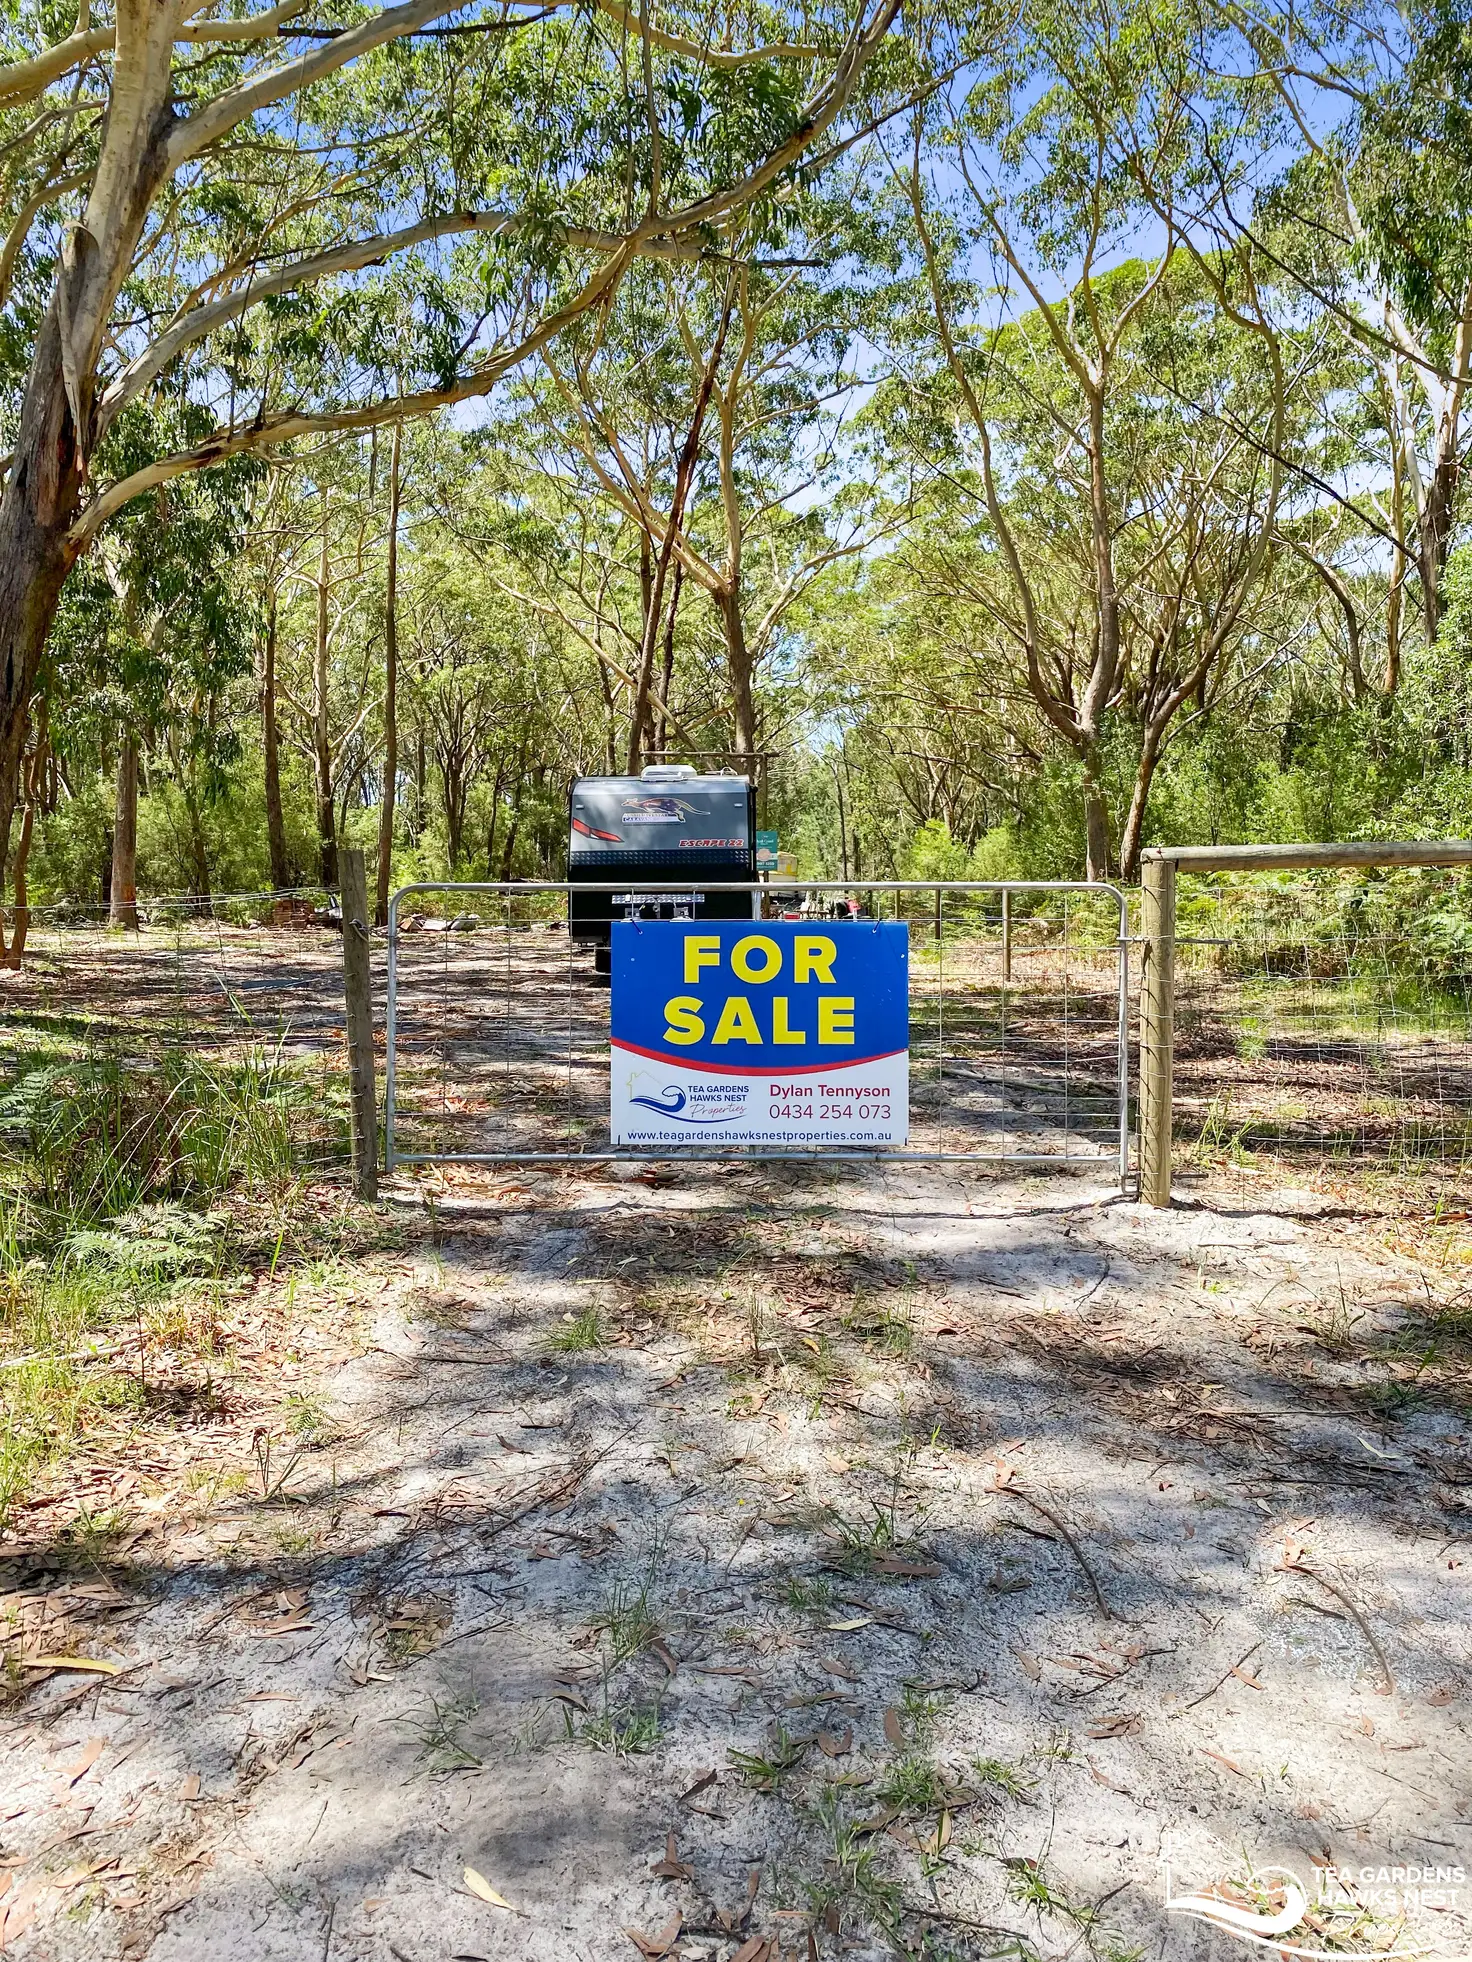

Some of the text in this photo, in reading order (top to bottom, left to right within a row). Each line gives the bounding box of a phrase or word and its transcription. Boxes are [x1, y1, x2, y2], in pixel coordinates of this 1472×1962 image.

[679, 839, 744, 847] ESCAPE 22
[684, 935, 837, 984] FOR
[662, 996, 855, 1045] SALE
[688, 1085, 749, 1093] TEA GARDENS
[770, 1084, 890, 1099] Dylan Tennyson
[690, 1094, 747, 1102] HAWKS NEST
[690, 1103, 748, 1118] Properties
[769, 1104, 891, 1119] 0434 254 073
[627, 1130, 892, 1142] www.teagardenshawksnestproperties.com.au
